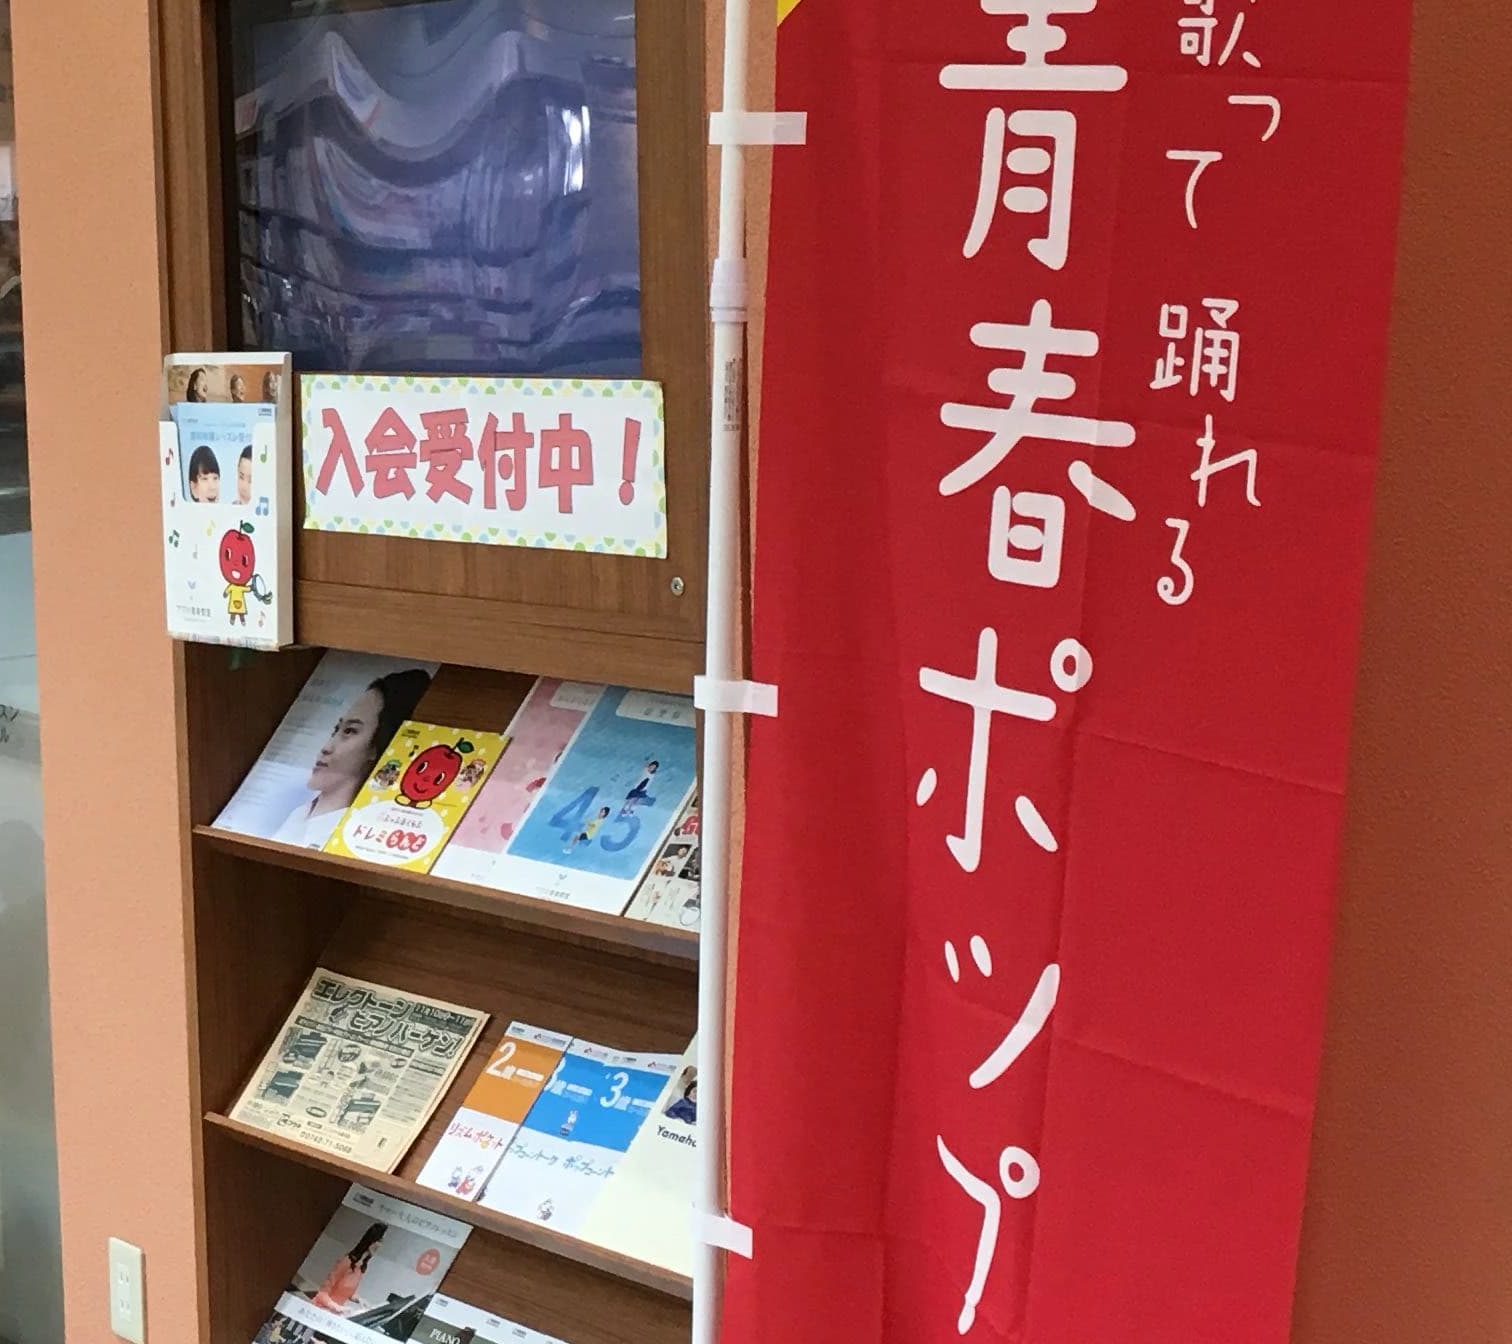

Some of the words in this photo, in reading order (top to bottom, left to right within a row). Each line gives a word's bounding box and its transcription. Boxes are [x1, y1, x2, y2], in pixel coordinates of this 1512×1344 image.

[315, 407, 642, 514] 入会受付中!
[311, 976, 412, 1020] エレクトーン
